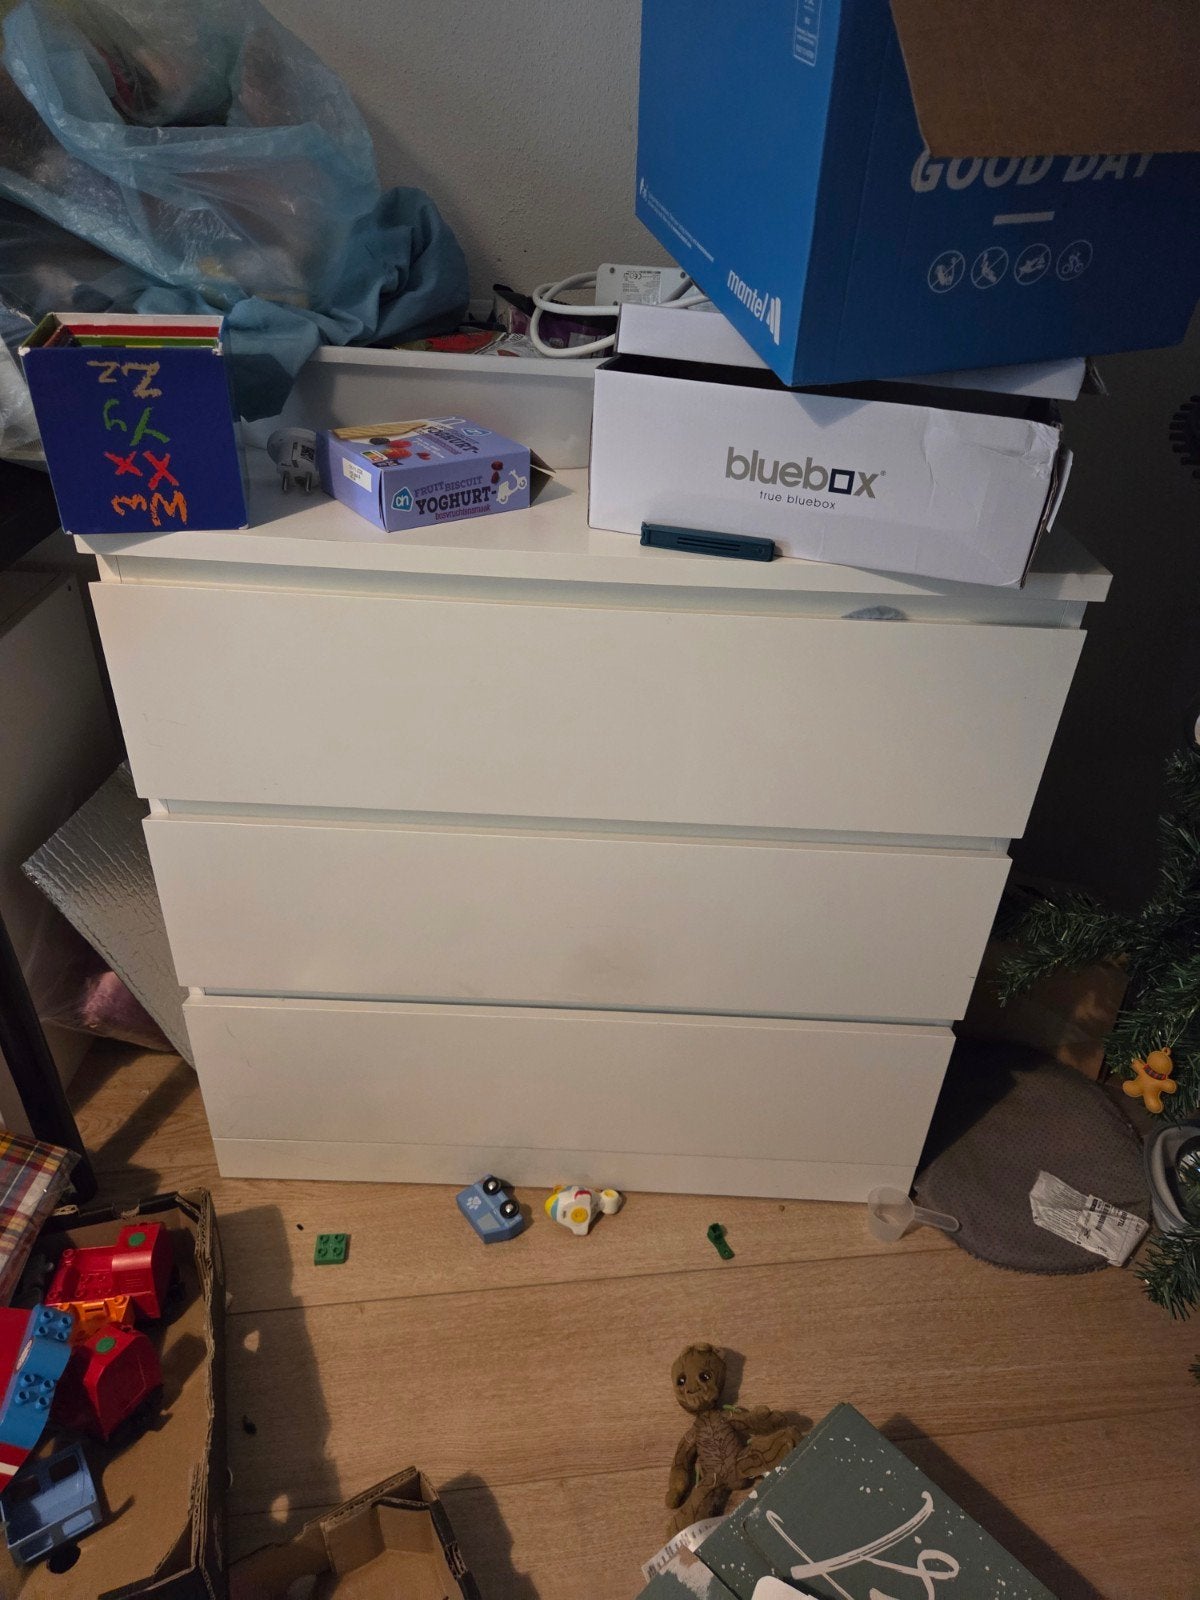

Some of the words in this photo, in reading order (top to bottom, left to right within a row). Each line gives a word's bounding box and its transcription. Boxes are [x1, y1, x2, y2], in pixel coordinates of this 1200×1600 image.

[910, 150, 1054, 193] GOOD
[726, 269, 769, 322] mantel
[414, 481, 445, 498] FRUIT
[445, 475, 483, 492] BISCUIT
[415, 485, 497, 515] YOGHURT-
[759, 490, 783, 502] true
[786, 494, 836, 510] bluebox
